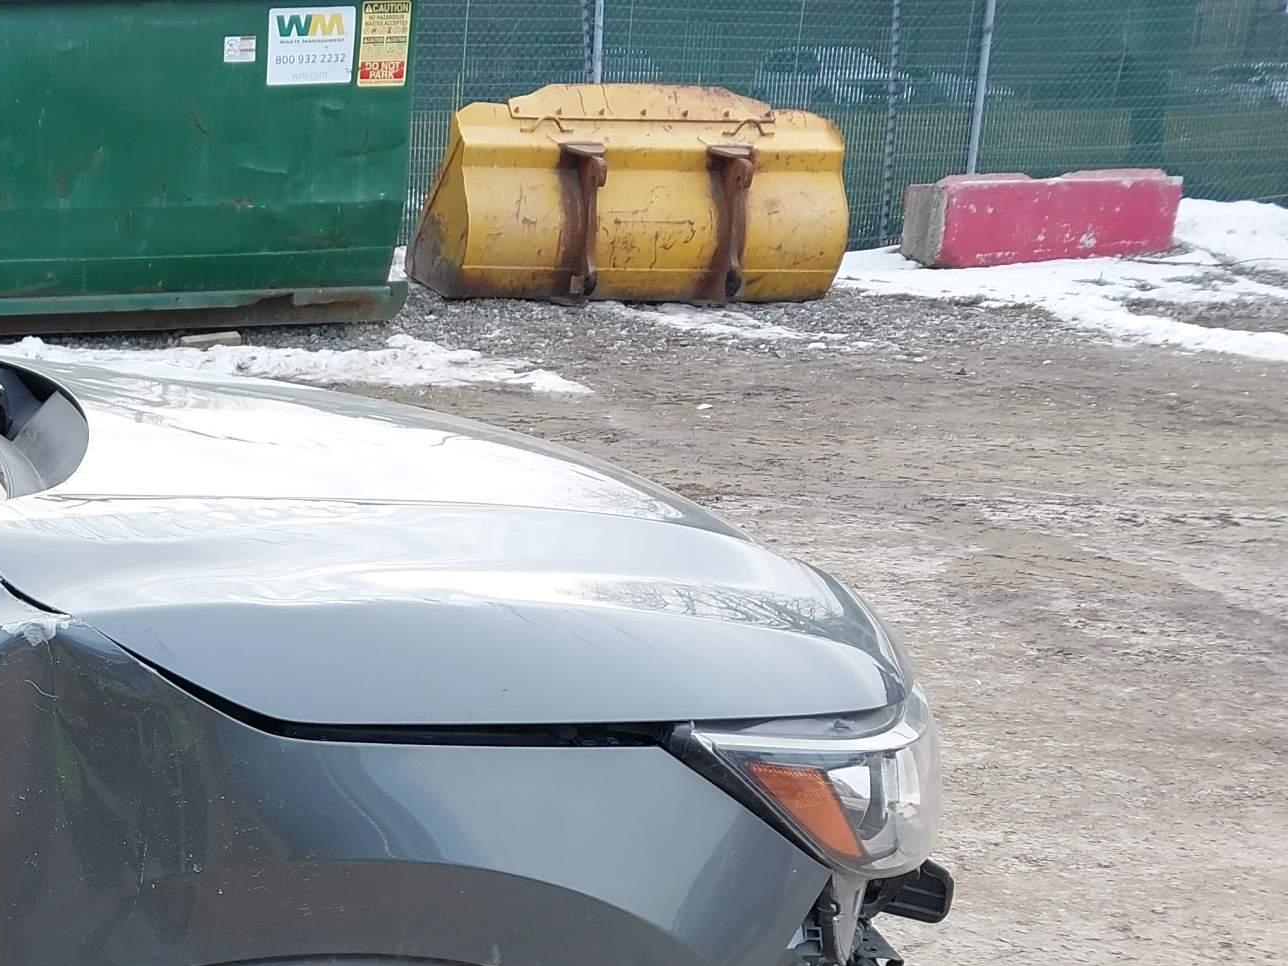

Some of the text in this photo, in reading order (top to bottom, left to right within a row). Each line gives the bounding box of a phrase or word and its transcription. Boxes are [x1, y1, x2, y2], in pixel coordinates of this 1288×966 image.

[372, 3, 409, 12] CAUTION
[276, 14, 344, 37] WM
[275, 53, 346, 64] 800 932 2232
[365, 61, 401, 71] DO NOT
[369, 70, 395, 79] PARK
